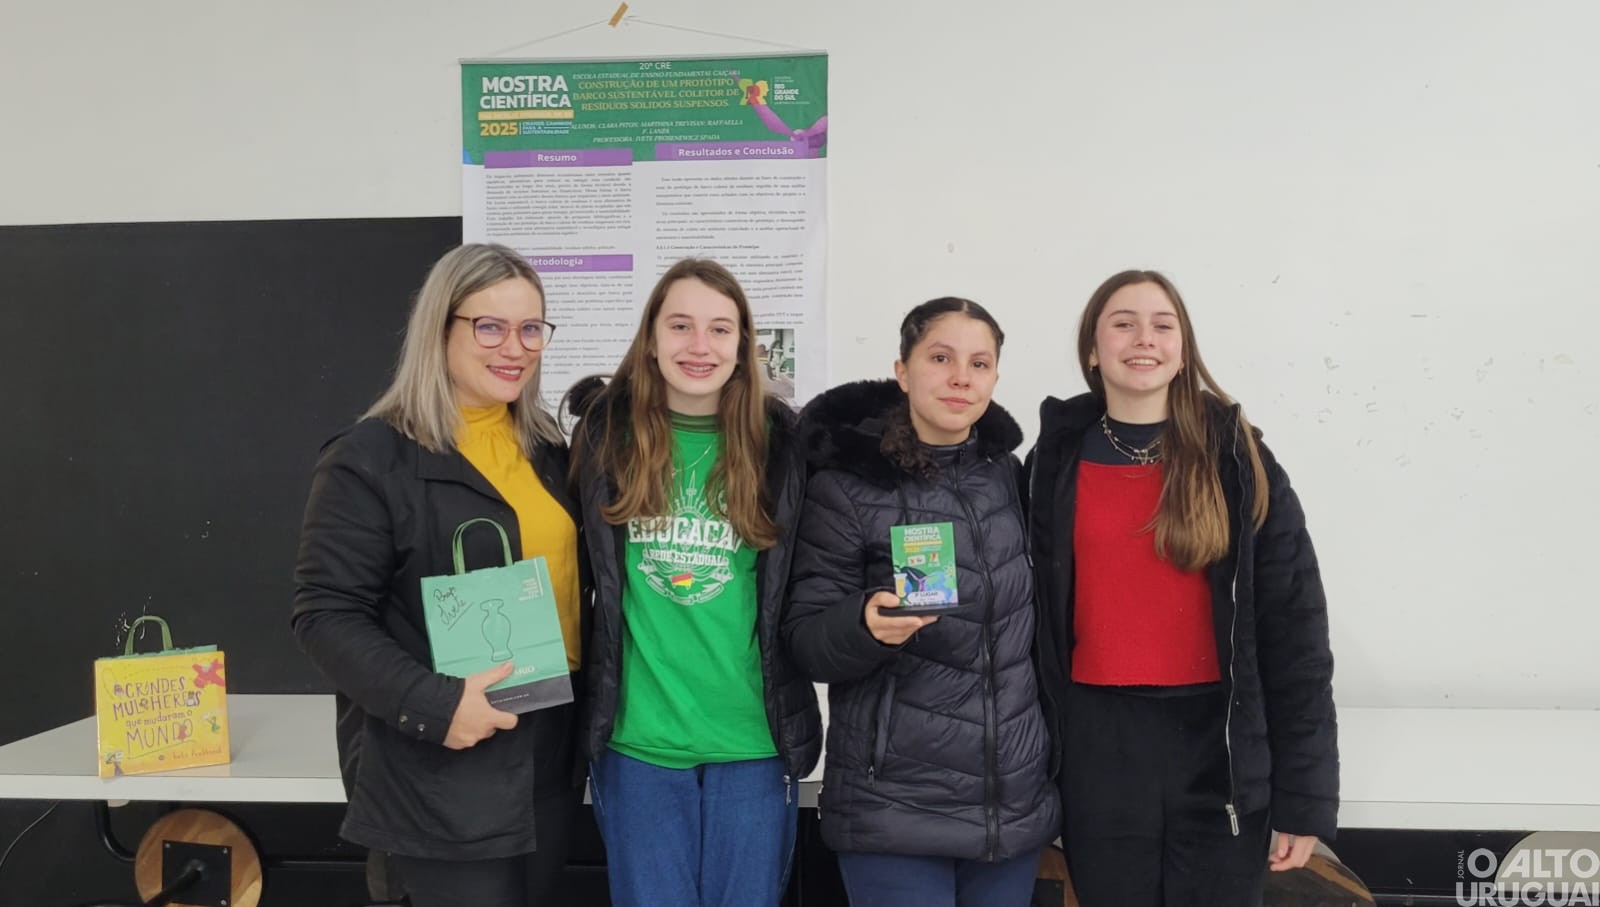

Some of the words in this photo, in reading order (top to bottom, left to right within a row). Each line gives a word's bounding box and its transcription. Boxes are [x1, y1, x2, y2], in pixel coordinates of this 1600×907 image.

[655, 61, 672, 70] CRE
[482, 75, 568, 93] MOSTRA
[578, 79, 644, 90] CONSTRUÇÃO
[646, 79, 660, 88] DE
[662, 79, 678, 88] UM
[678, 88, 724, 97] COLETOR
[726, 87, 740, 96] DE
[480, 92, 572, 109] CIENTÍFICA
[674, 99, 729, 108] SUSPENSOS
[480, 121, 518, 136] 2025
[678, 147, 732, 157] Resultados
[743, 146, 794, 156] Conclusão
[537, 154, 577, 162] Resumo
[126, 719, 142, 729] que
[143, 712, 186, 726] mudaram
[126, 718, 194, 754] MUNDO
